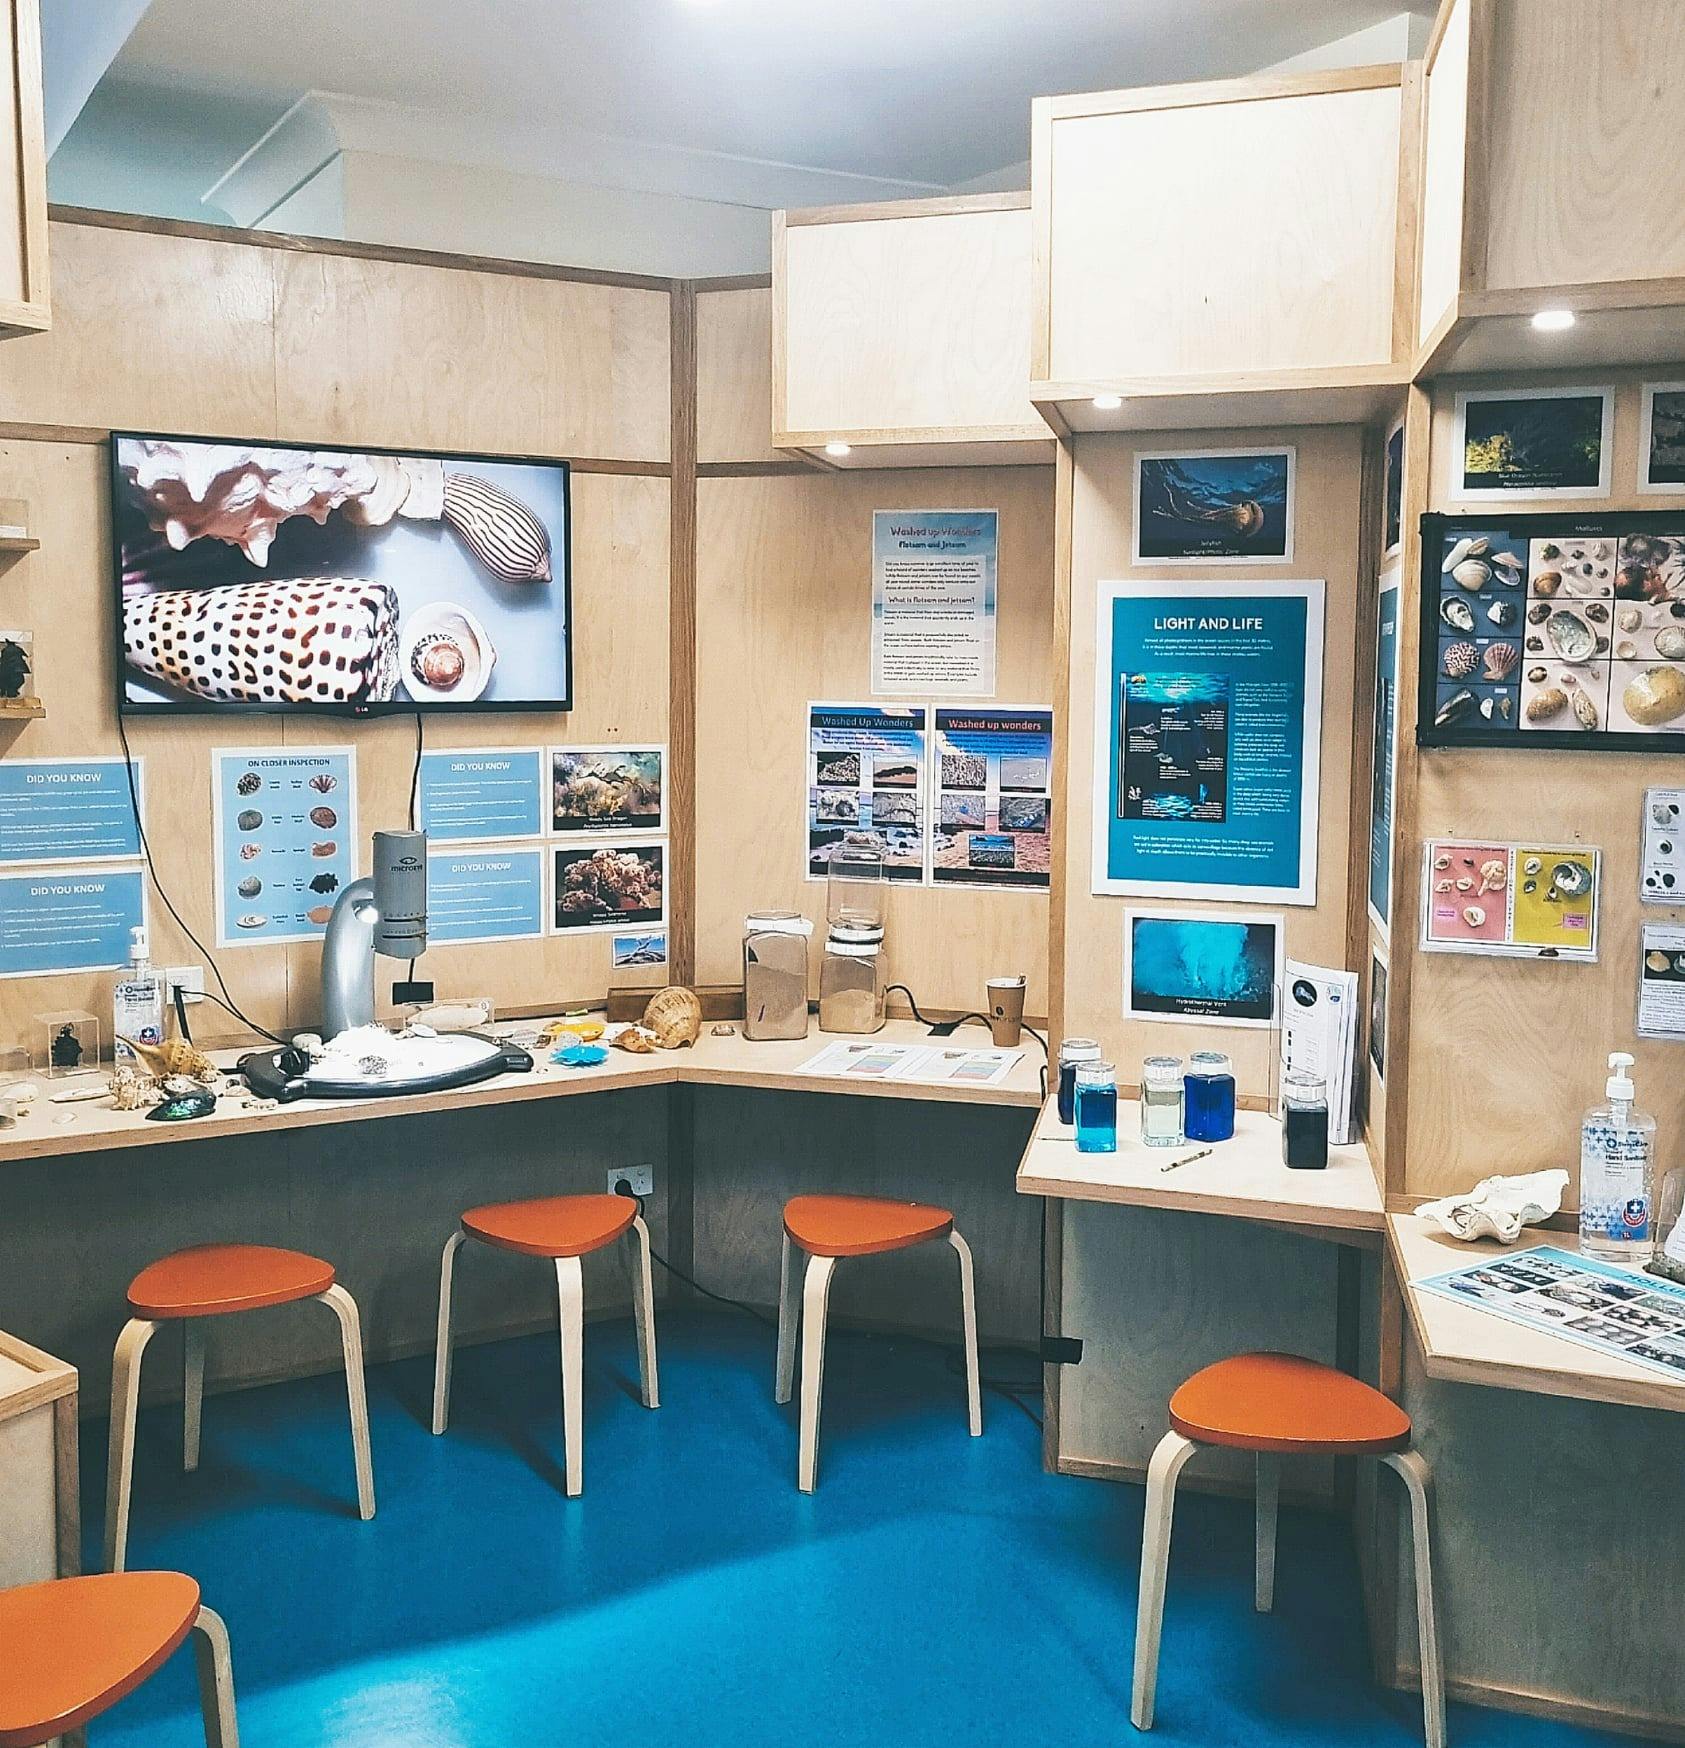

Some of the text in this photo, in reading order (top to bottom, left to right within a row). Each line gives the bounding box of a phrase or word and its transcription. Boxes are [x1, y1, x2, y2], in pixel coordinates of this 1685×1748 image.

[890, 526, 981, 538] Washed up Wonders
[941, 541, 967, 550] Jetsam
[1154, 618, 1263, 630] LIGHT AND LIFE
[821, 716, 913, 728] Washed Up Wonders
[948, 719, 1041, 732] Washed up wonders
[451, 762, 511, 771] DID YOU KNOW
[26, 773, 102, 783] DID YOU KNOW
[486, 862, 512, 870] KNOW
[31, 884, 105, 896] DID YOU KNOW
